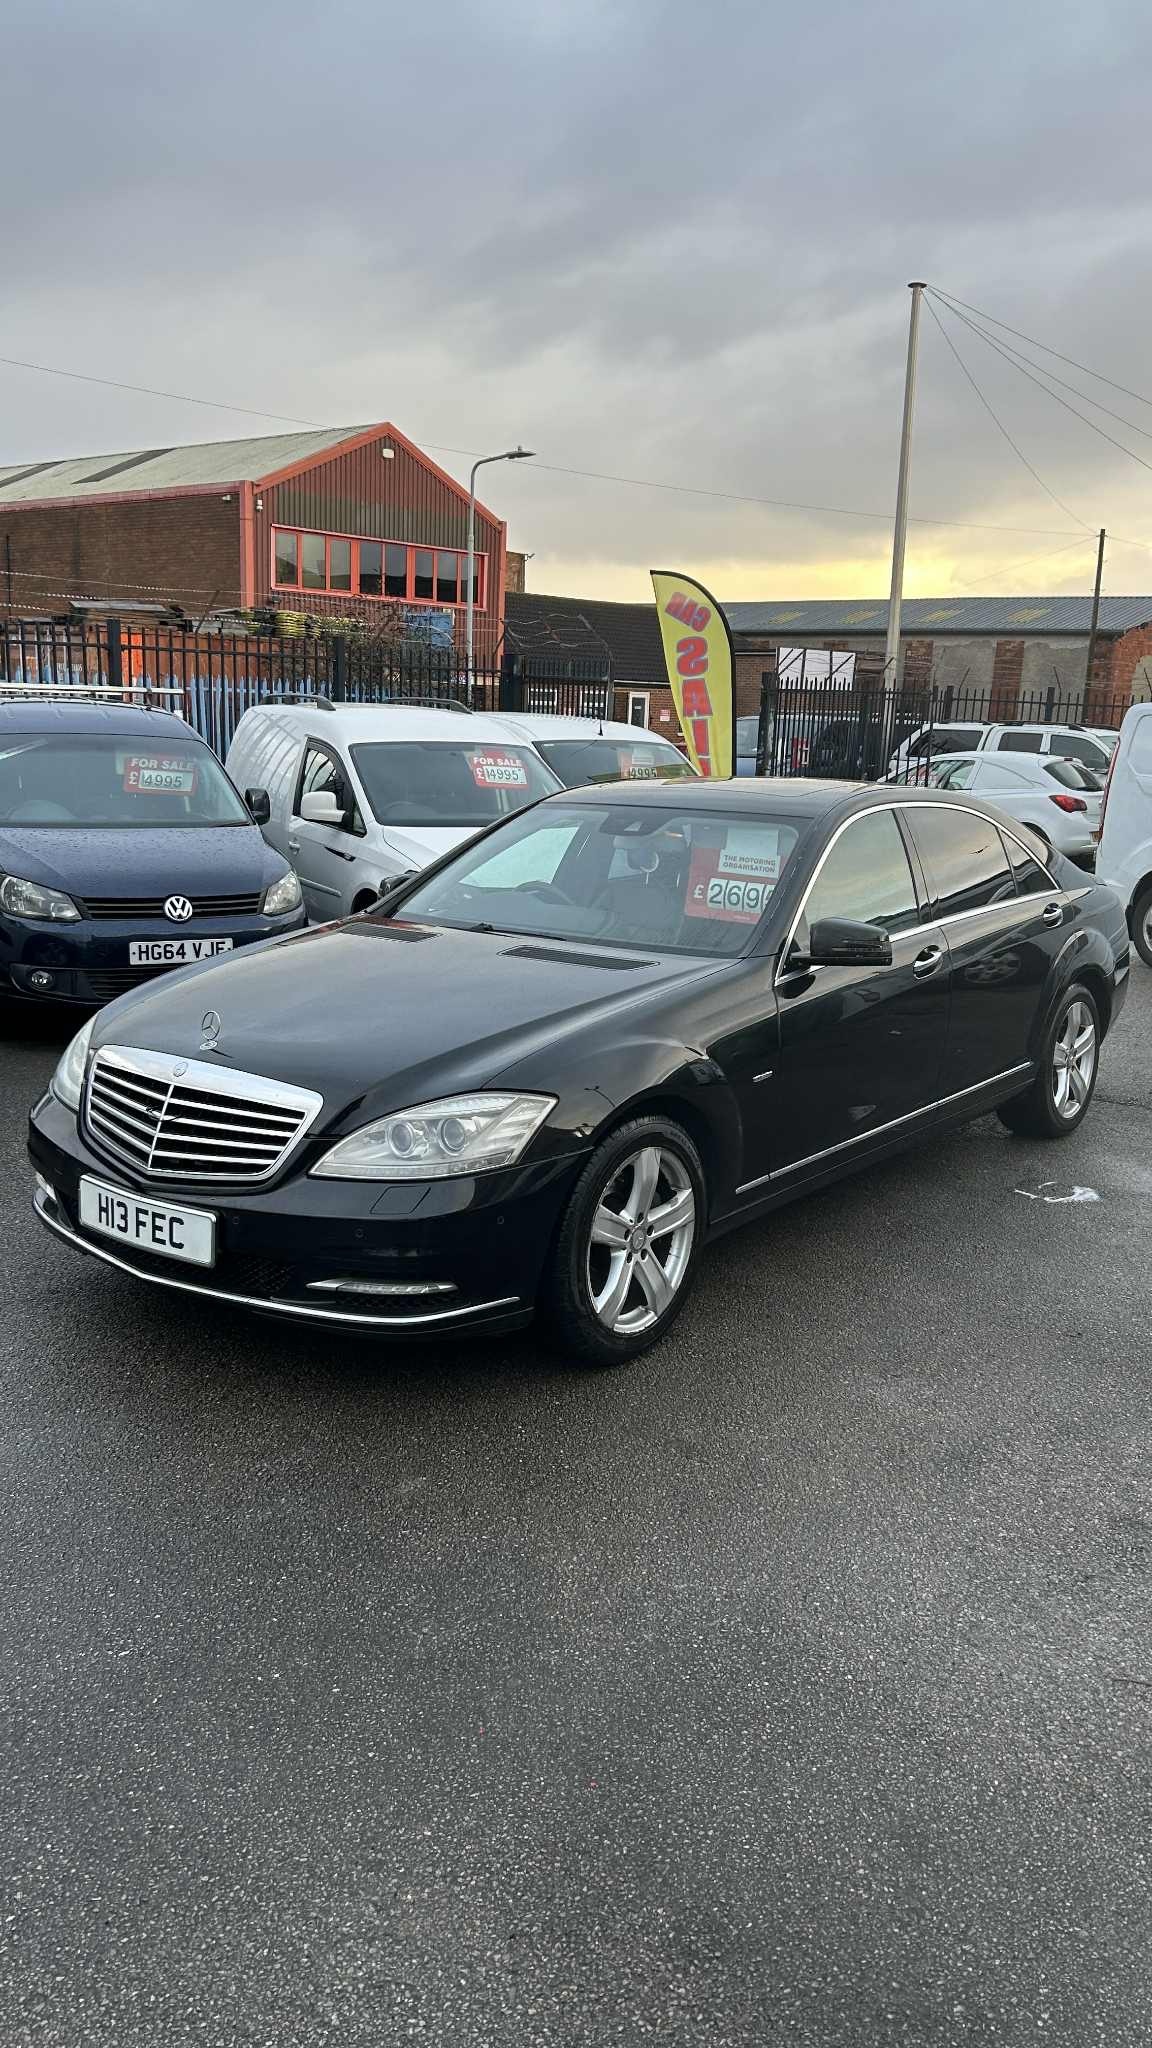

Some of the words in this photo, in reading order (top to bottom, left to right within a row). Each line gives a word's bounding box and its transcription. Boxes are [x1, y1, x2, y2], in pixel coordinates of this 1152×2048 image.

[131, 758, 158, 769] FOR
[161, 759, 193, 772] SALE
[473, 757, 495, 765] FOR
[496, 758, 522, 767] SALE
[724, 854, 737, 862] THE
[739, 856, 776, 867] MOTORING
[723, 862, 775, 873] ORGANISATION
[138, 943, 186, 960] HG64
[98, 1193, 128, 1233] H13
[136, 1207, 184, 1249] FEC
